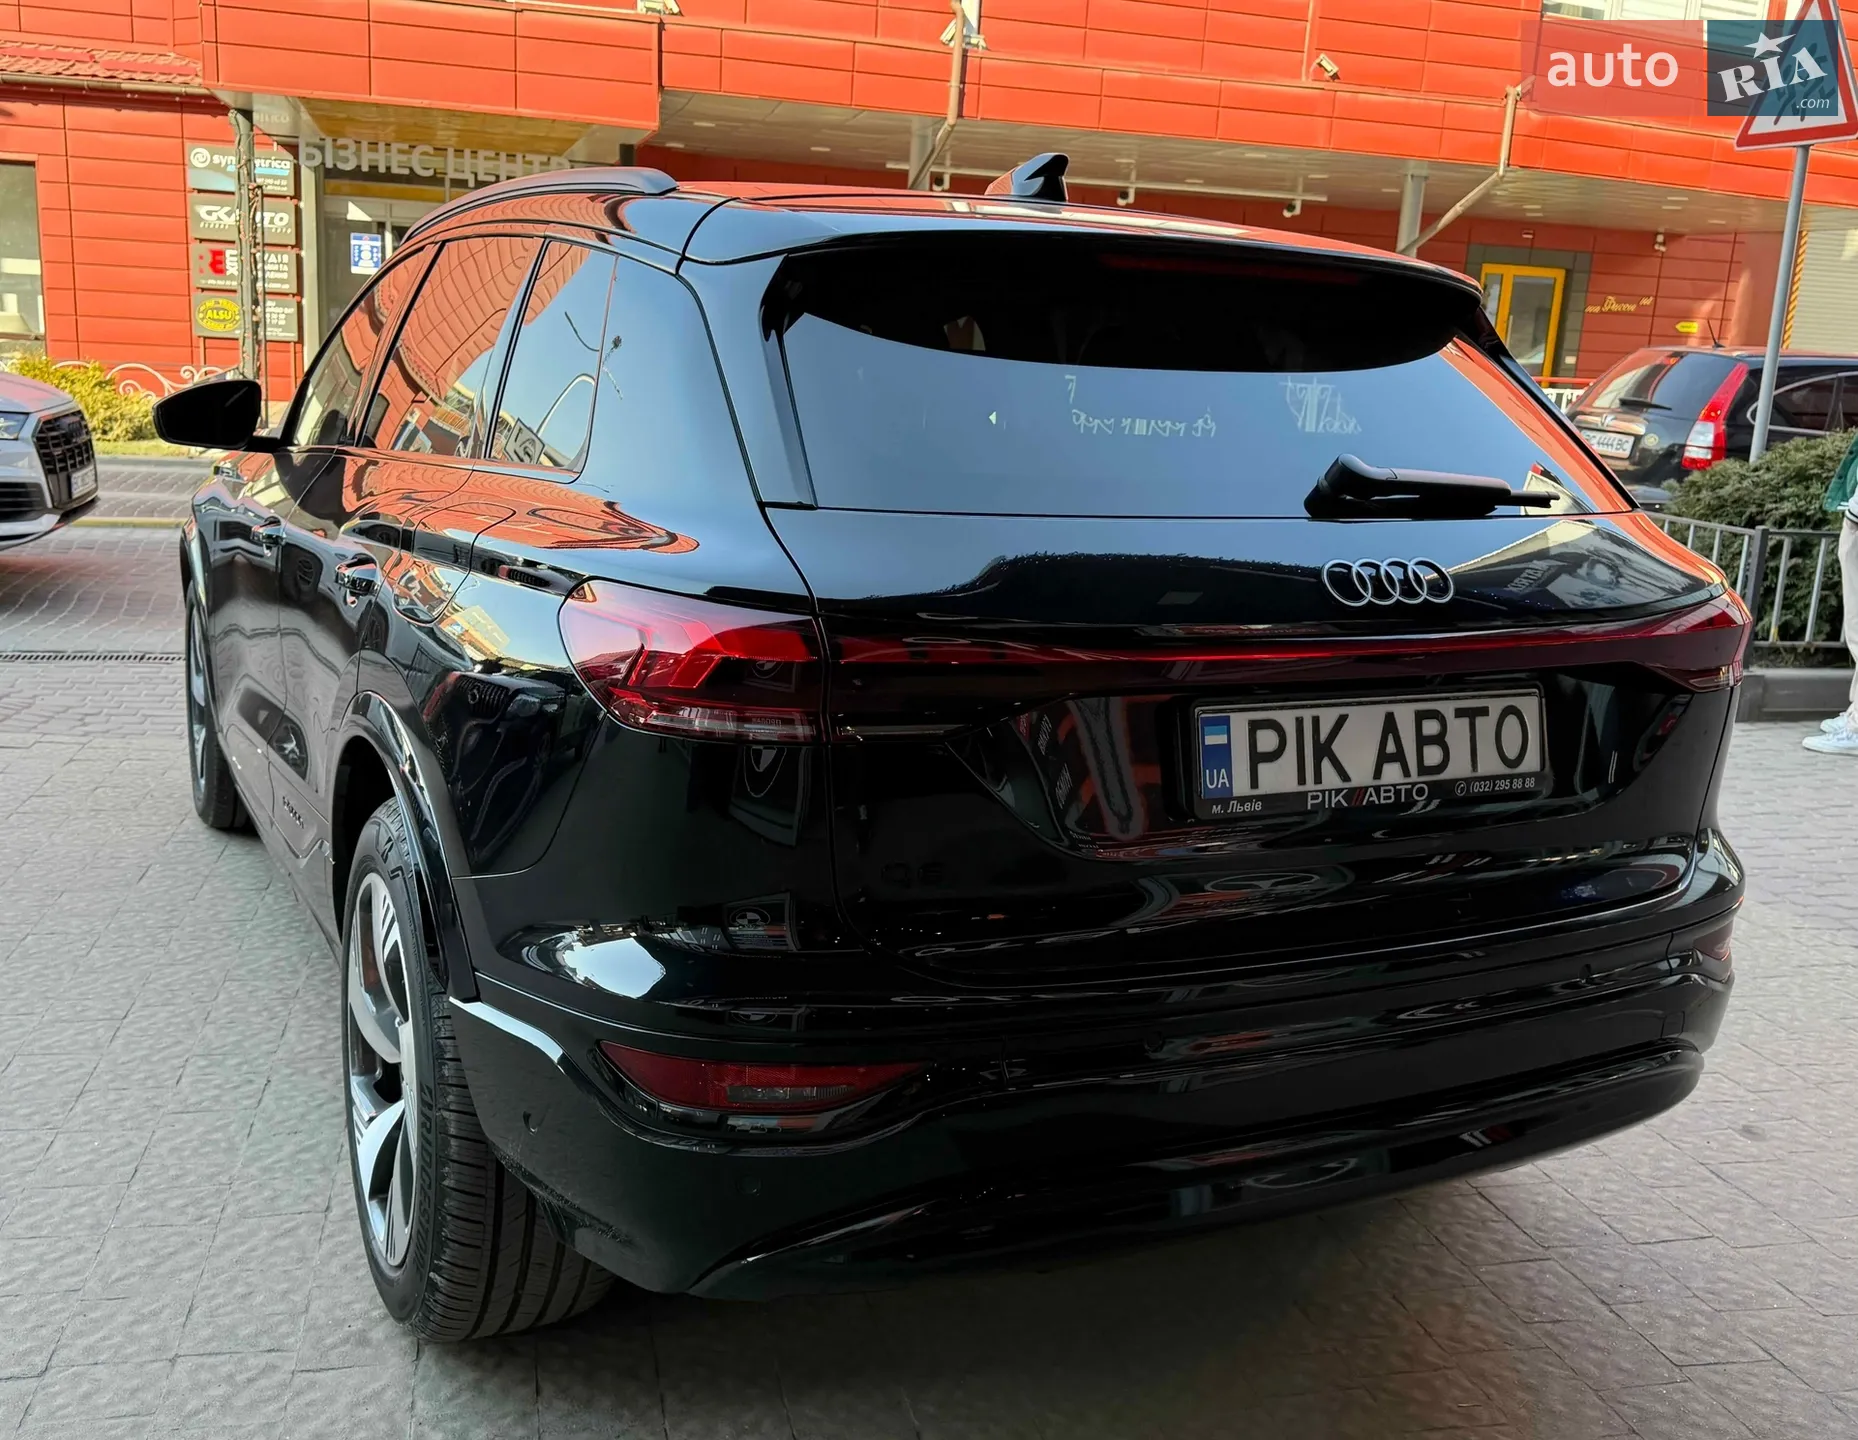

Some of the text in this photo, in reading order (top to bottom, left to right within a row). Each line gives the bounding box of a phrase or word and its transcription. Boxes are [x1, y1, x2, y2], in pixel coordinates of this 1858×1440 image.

[299, 136, 434, 178] БІЗНЕС
[206, 309, 232, 320] ALSU
[1372, 704, 1529, 780] АВТО
[1205, 768, 1230, 789] UA
[1469, 776, 1536, 793] (032) 295 88 88
[1227, 798, 1263, 813] Львів
